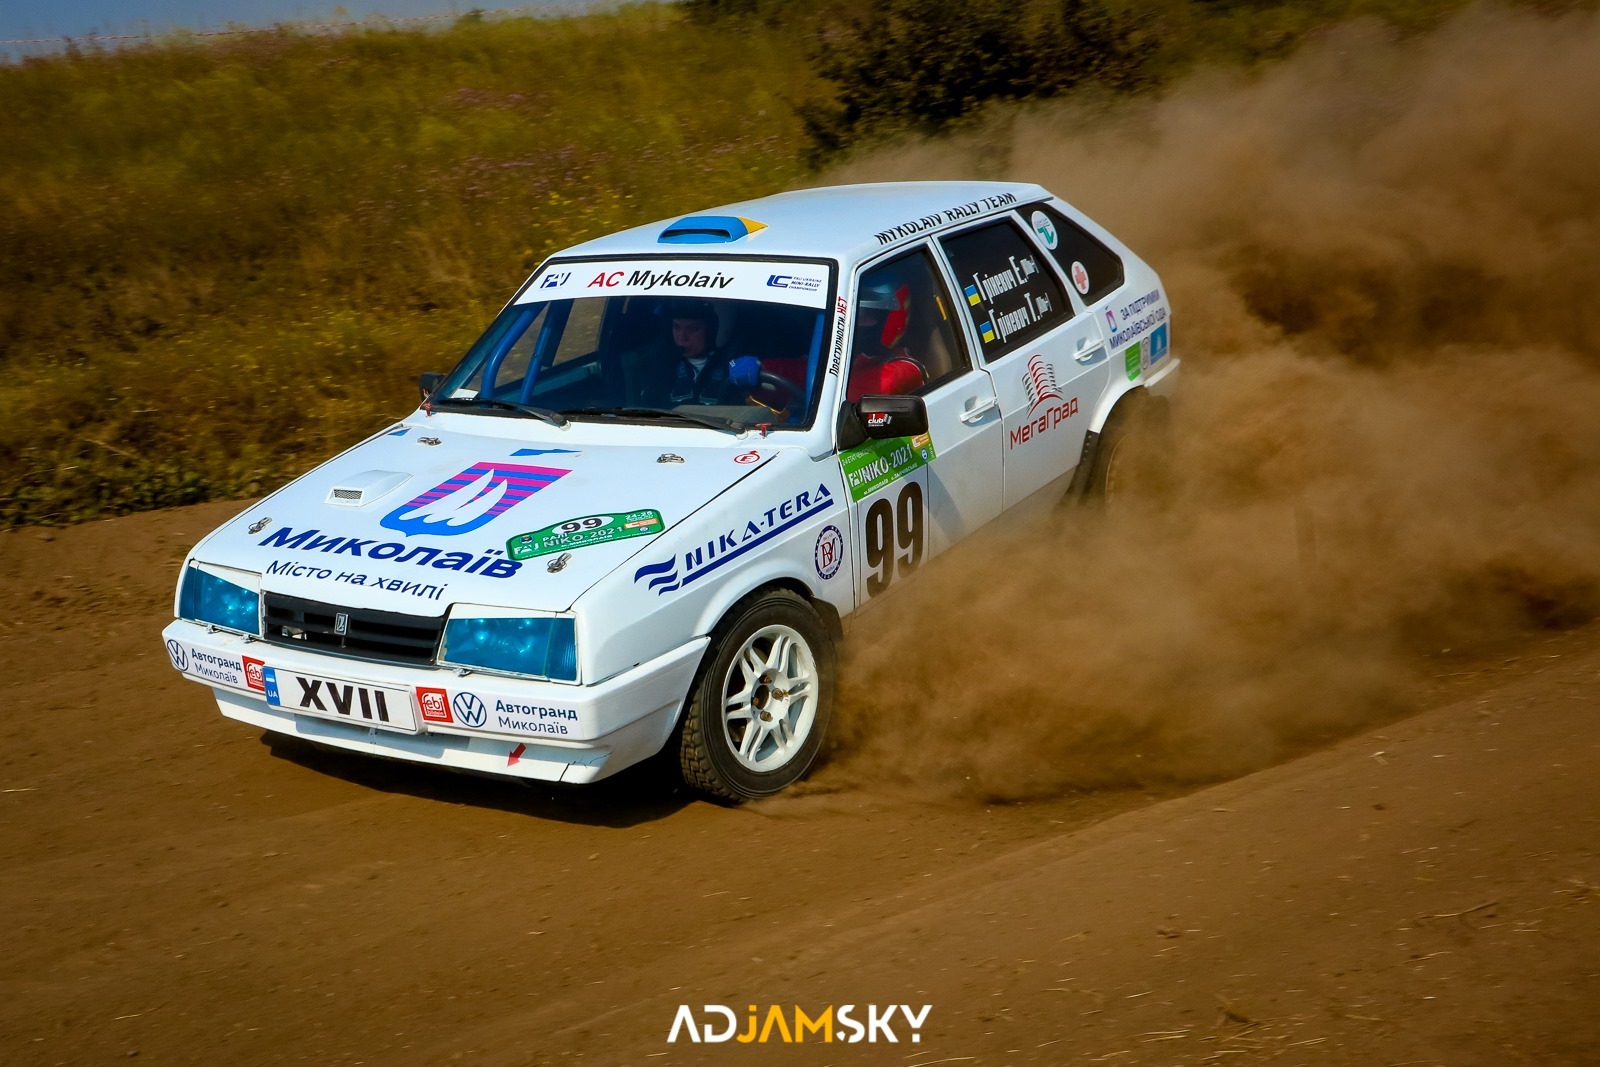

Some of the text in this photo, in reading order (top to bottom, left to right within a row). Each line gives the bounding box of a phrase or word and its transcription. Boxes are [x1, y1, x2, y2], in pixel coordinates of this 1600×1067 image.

[874, 192, 1017, 245] MYKOLAIV RALLY TEAM
[587, 270, 735, 290] AC Mykolaiv
[973, 269, 1017, 304] Гріневич
[988, 306, 1030, 343] Гріневич
[1120, 307, 1130, 320] ЗА
[1010, 397, 1079, 450] МегаГрад
[862, 443, 913, 484] NIKO-2021
[543, 526, 623, 548] NIKO-2021
[561, 517, 603, 533] 99
[685, 483, 832, 572] NIKA-TERA
[258, 527, 524, 579] Миколаїв
[865, 481, 923, 599] 99
[265, 560, 448, 601] Місто на хвилі
[191, 648, 243, 672] Автогранд
[194, 662, 238, 684] Миколаїв
[268, 689, 278, 698] UA
[296, 676, 390, 722] XVII
[422, 692, 443, 711] febi
[495, 699, 578, 721] Автогранд
[498, 716, 568, 735] Миколаїв
